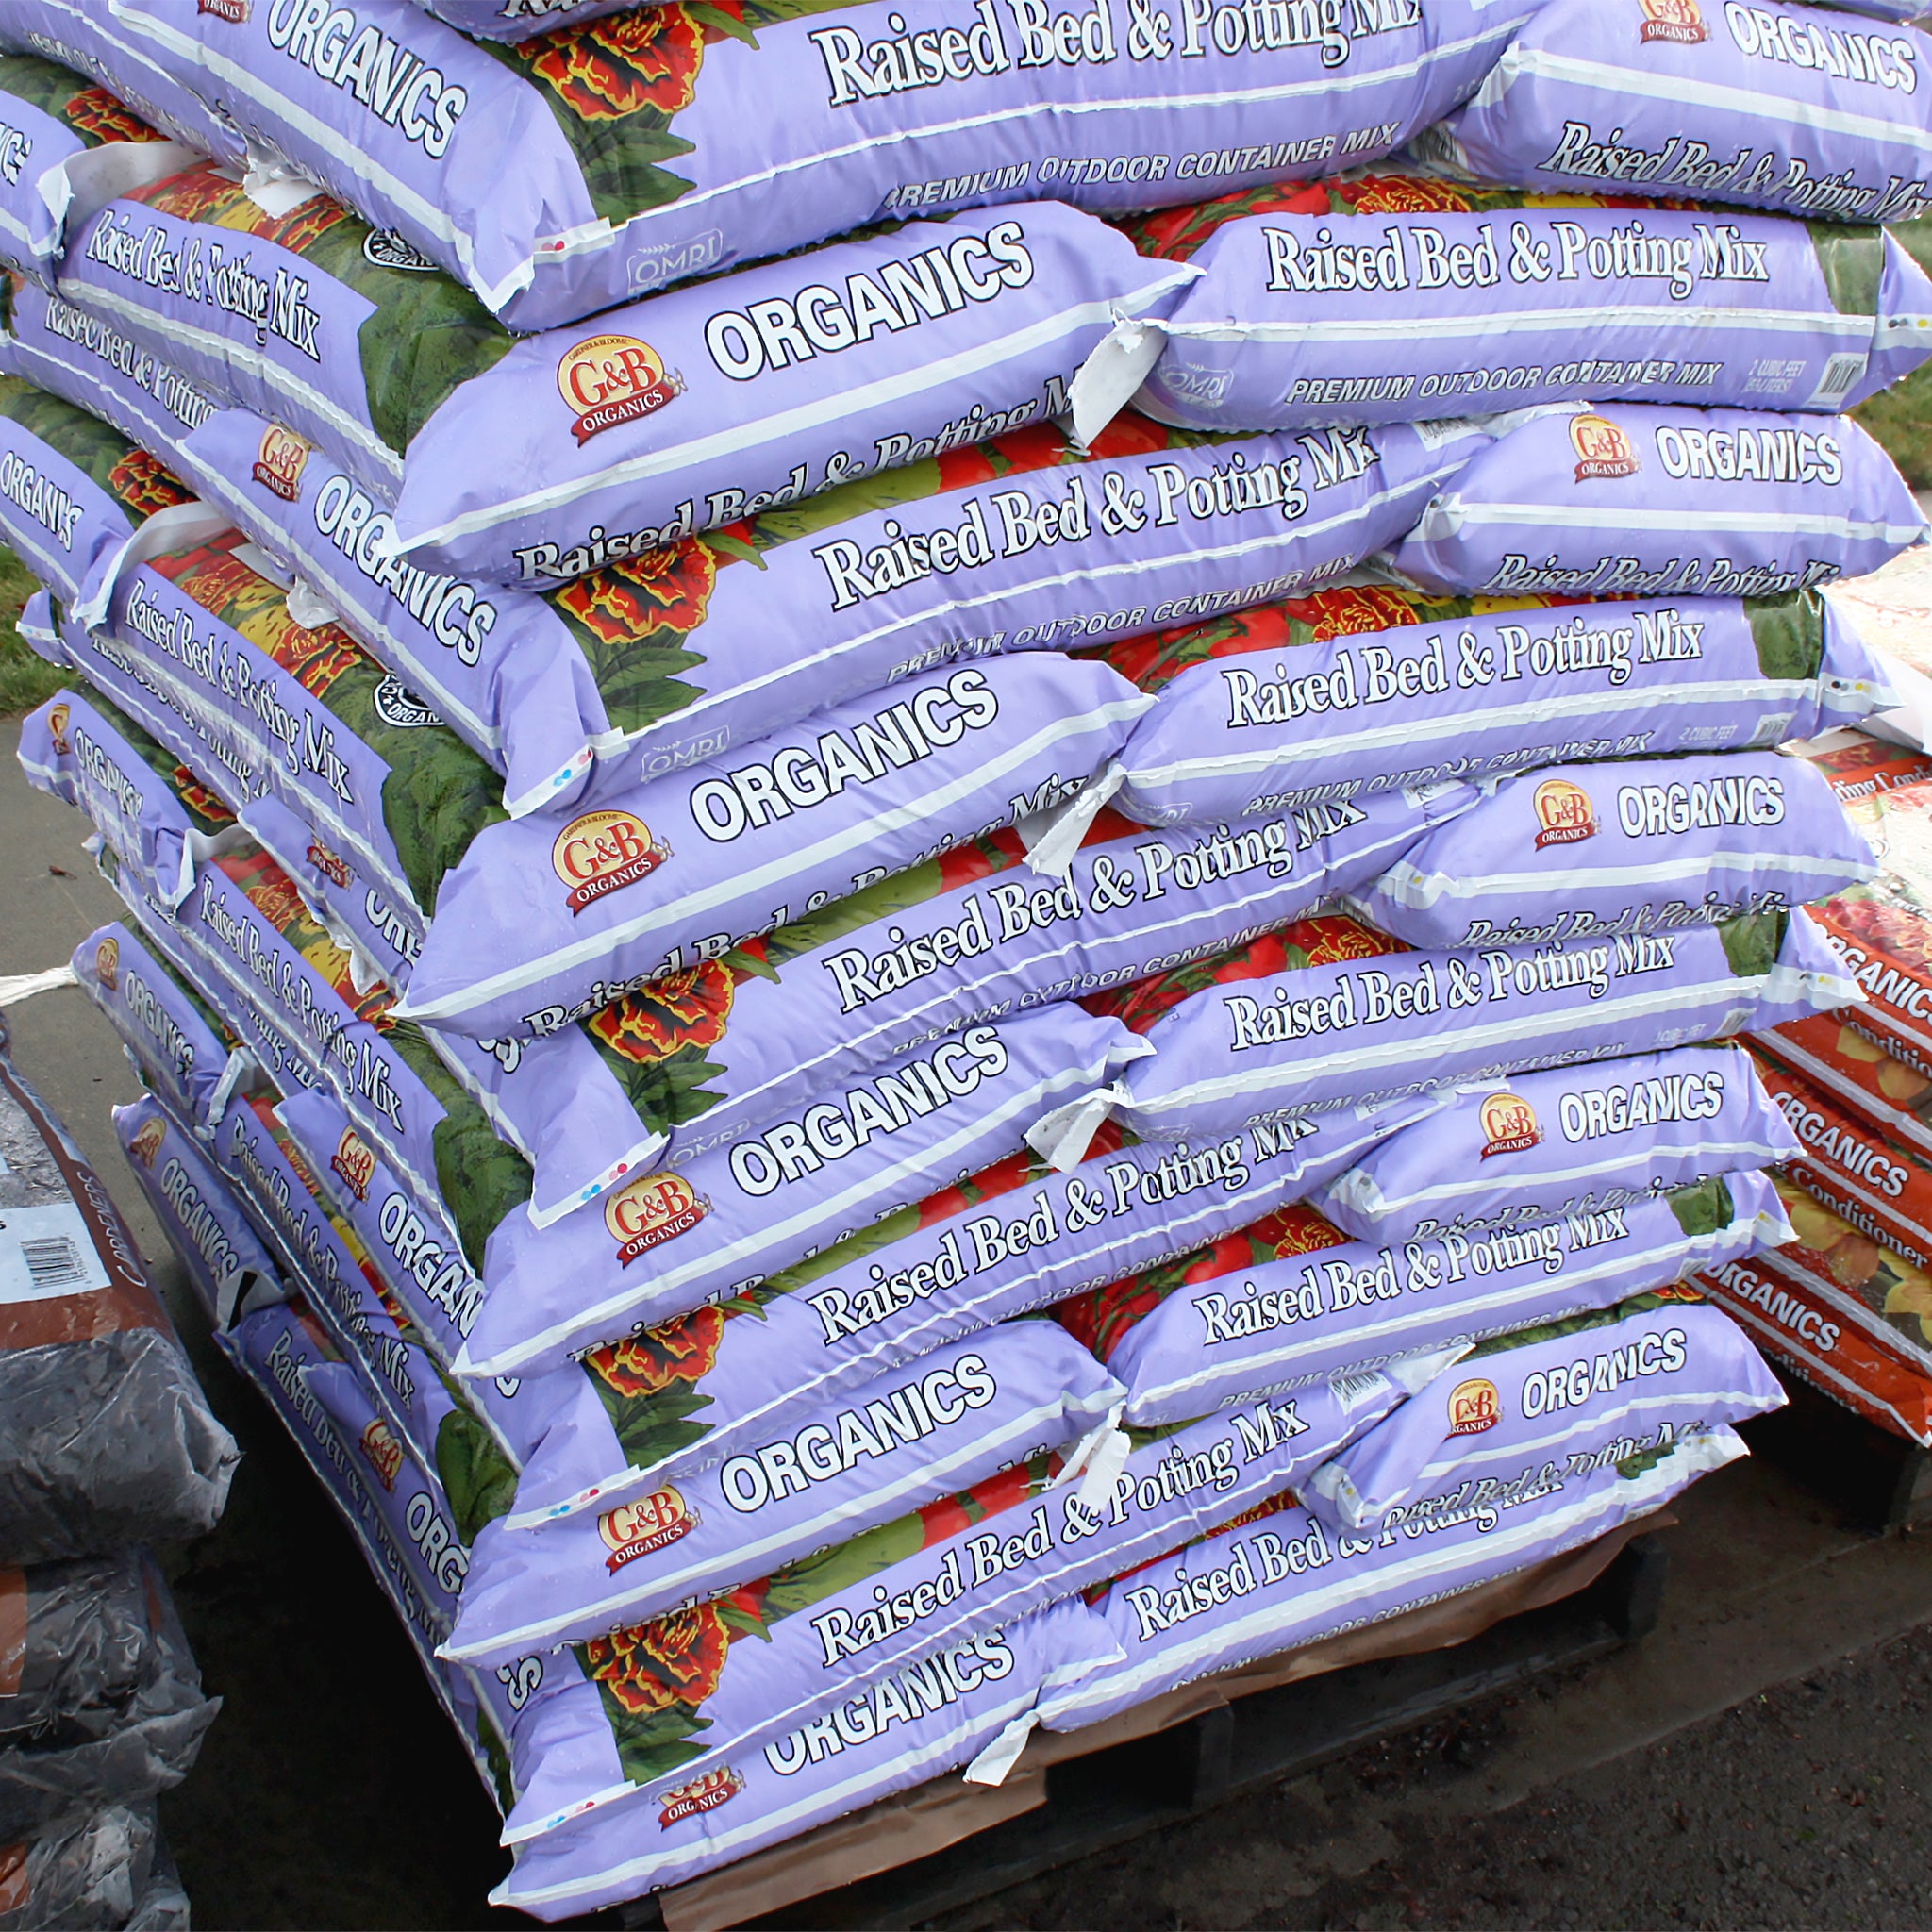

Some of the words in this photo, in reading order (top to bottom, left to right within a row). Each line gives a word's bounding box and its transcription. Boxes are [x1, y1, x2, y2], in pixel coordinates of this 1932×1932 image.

[808, 8, 1010, 108] Raised
[1015, 0, 1117, 70] Bed
[1128, 0, 1174, 62] &
[1180, 0, 1350, 69] Potting
[1646, 24, 1699, 42] ORGANICS
[1724, 2, 1918, 93] ORGANICS
[268, 0, 468, 159] ORGANICS
[1175, 134, 1336, 179] CONTAINER
[1343, 122, 1401, 156] MIX
[1536, 121, 1679, 184] Raised
[1662, 140, 1751, 190] Bed
[1730, 153, 1775, 193] &
[1771, 158, 1877, 217] Potting
[86, 210, 146, 271] Raised
[184, 253, 205, 301] &
[271, 267, 321, 363] Mix
[635, 232, 720, 283] OMRI
[1262, 225, 1410, 292] Raised
[1415, 224, 1501, 289] Bed
[1510, 220, 1551, 284] &
[1550, 222, 1694, 300] Potting
[1696, 223, 1770, 282] Mix
[705, 221, 1035, 380] ORGANICS
[567, 347, 658, 408] G&B
[581, 388, 664, 433] ORGANICS
[1286, 375, 1415, 406] PREMIUM
[1418, 364, 1541, 398] OUTDOOR
[1674, 361, 1724, 386] MIX
[263, 423, 308, 478] G&B
[1576, 427, 1627, 458] G&B
[1581, 461, 1628, 475] ORGANICS
[1654, 425, 1844, 486] ORGANICS
[514, 501, 695, 581] Raised
[706, 465, 809, 529] Bed
[812, 451, 866, 487] &
[813, 500, 996, 612] Raised
[993, 475, 1092, 559] Bed
[1100, 471, 1148, 537] &
[1148, 450, 1310, 526] Potting
[1151, 572, 1303, 624] CONTAINER
[1309, 553, 1357, 584] MIX
[124, 578, 181, 657] Raised
[180, 614, 217, 690] Bed
[220, 643, 238, 698] &
[236, 653, 300, 776] Potting
[303, 710, 355, 804] Mix
[1222, 641, 1360, 729] Raised
[1359, 635, 1450, 706] Bed
[1456, 631, 1496, 691] &
[1496, 616, 1636, 686] Potting
[1633, 607, 1706, 665] Mix
[690, 668, 1000, 843] ORGANICS
[1241, 778, 1363, 817] PREMIUM
[1541, 791, 1594, 824] G&B
[1617, 775, 1786, 838] ORGANICS
[561, 819, 645, 885] G&B
[1541, 825, 1589, 845] ORGANICS
[576, 856, 654, 907] ORGANICS
[824, 893, 993, 1015] Raised
[989, 865, 1082, 944] Bed
[1087, 855, 1135, 919] &
[1136, 817, 1301, 903] Potting
[201, 875, 248, 967] Raised
[280, 963, 302, 1016] &
[358, 1036, 406, 1135] Mix
[1224, 974, 1361, 1052] Raised
[1357, 960, 1443, 1026] Bed
[1445, 958, 1485, 1010] &
[1480, 944, 1610, 1002] Potting
[1612, 931, 1675, 978] Mix
[728, 1024, 1009, 1197] ORGANICS
[1485, 1105, 1536, 1138] G&B
[1558, 1072, 1725, 1143] ORGANICS
[337, 1128, 378, 1183] G&B
[1487, 1136, 1536, 1155] ORGANICS
[159, 1157, 240, 1285] ORGANICS
[611, 1180, 693, 1239] G&B
[625, 1210, 697, 1259] ORGANICS
[808, 1263, 968, 1347] Raised
[965, 1188, 1060, 1281] Bed
[1065, 1176, 1106, 1233] &
[1106, 1136, 1251, 1218] Potting
[1792, 1166, 1928, 1269] Conditioner
[378, 1191, 484, 1340] ORGAN
[1191, 1268, 1328, 1347] Raised
[1323, 1245, 1402, 1313] Bed
[1405, 1243, 1443, 1292] &
[1439, 1227, 1563, 1285] Potting
[379, 1325, 416, 1412] Mix
[1218, 1372, 1326, 1410] PREMIUM
[720, 1354, 997, 1514] ORGANICS
[1452, 1419, 1493, 1435] RGANICS
[605, 1488, 687, 1548] G&B
[614, 1524, 686, 1563] ORGANICS
[811, 1548, 967, 1668] Raised
[965, 1509, 1055, 1593] Bed
[1105, 1445, 1241, 1527] Potting
[1125, 1557, 1258, 1643] Raised
[1252, 1517, 1333, 1588] Bed
[763, 1630, 1015, 1777] ORGANICS
